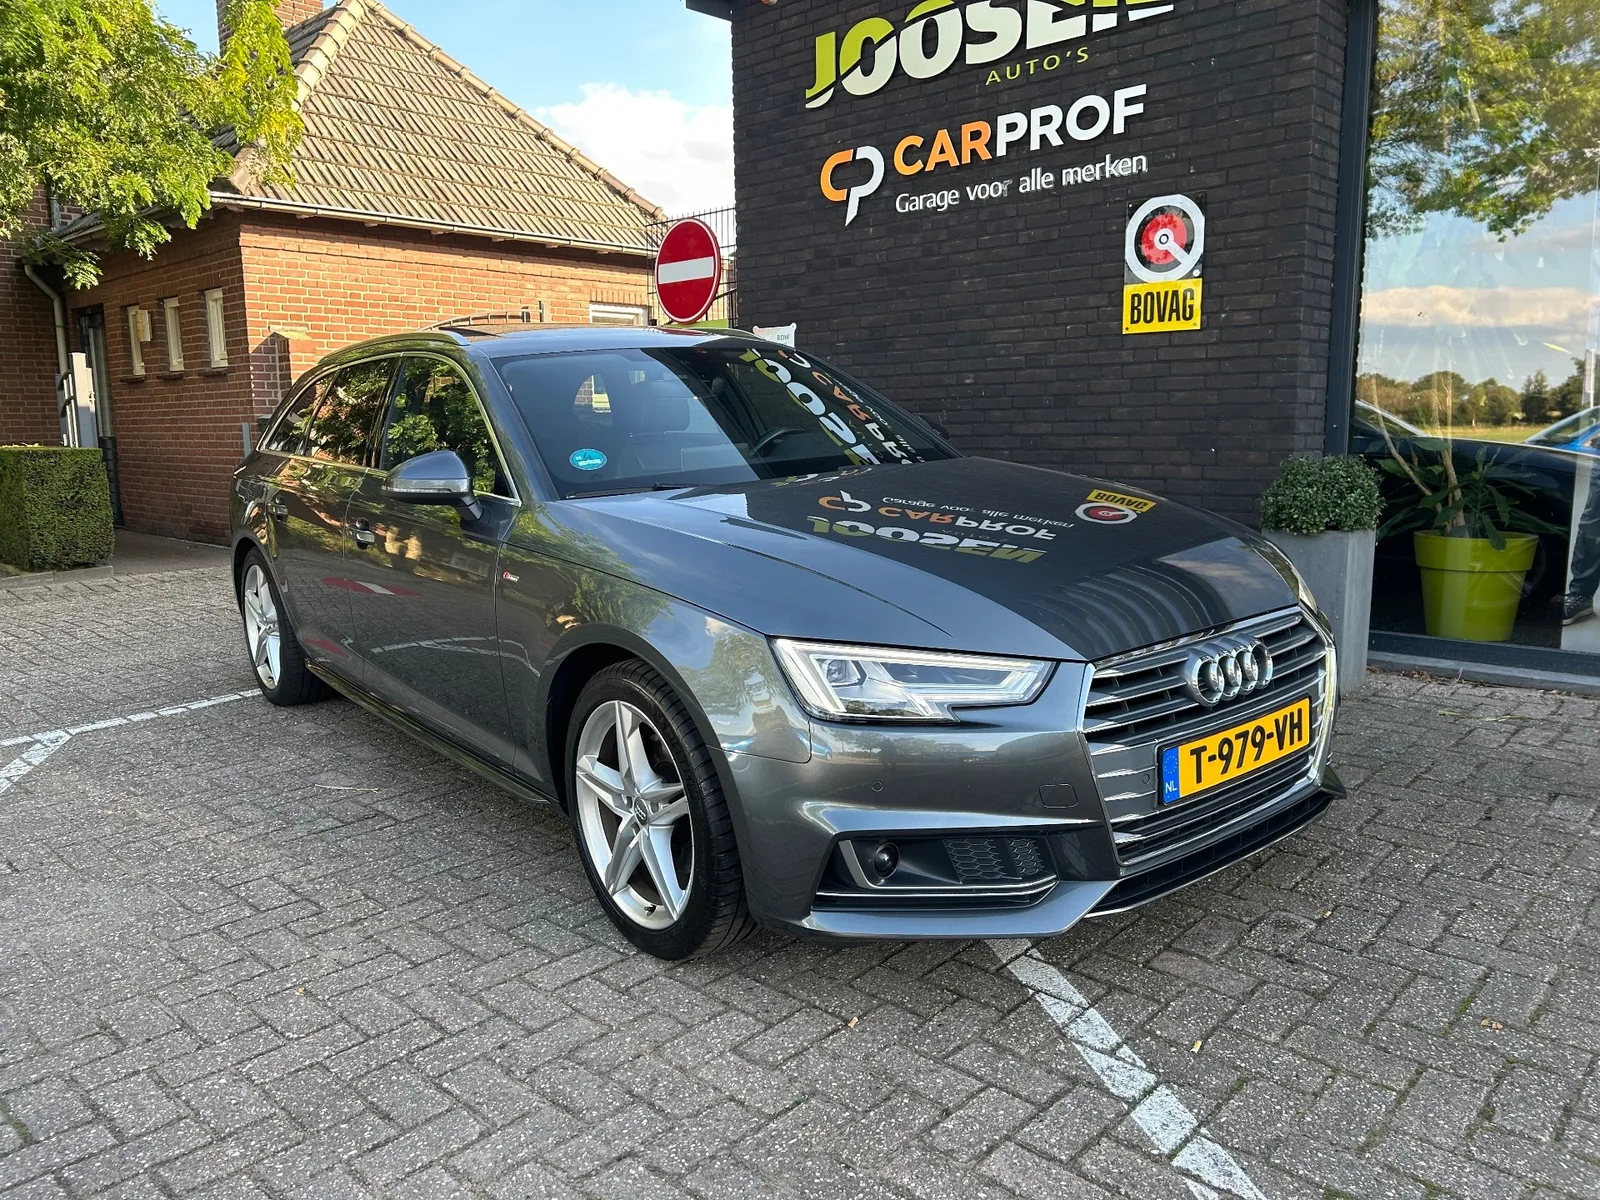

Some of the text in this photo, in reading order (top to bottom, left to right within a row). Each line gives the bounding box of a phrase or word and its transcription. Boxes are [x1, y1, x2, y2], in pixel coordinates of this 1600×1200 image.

[985, 47, 1089, 85] AUTO'S
[893, 84, 1147, 175] CARPROF
[895, 187, 960, 213] Garage
[1018, 166, 1054, 193] alle
[1062, 153, 1148, 187] merken
[1130, 288, 1195, 325] BOVAG
[1190, 707, 1302, 785] T-979-VH
[1165, 781, 1177, 793] NL
